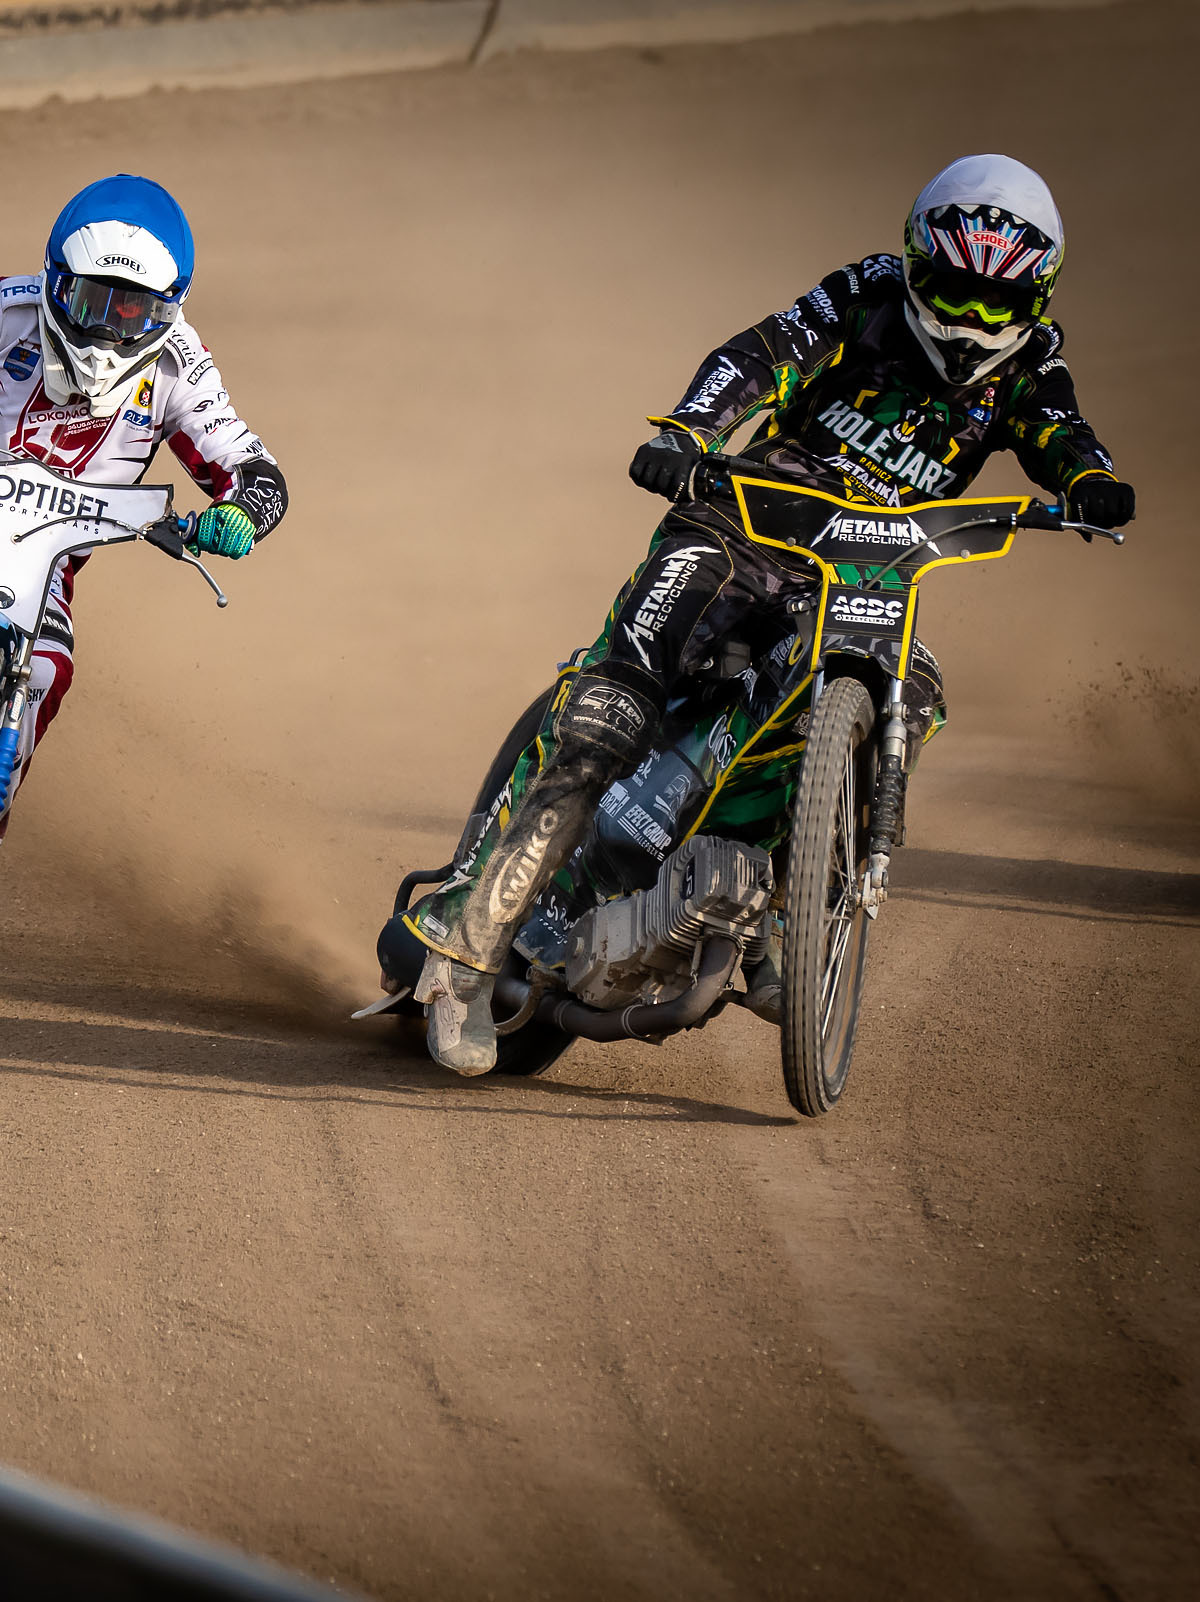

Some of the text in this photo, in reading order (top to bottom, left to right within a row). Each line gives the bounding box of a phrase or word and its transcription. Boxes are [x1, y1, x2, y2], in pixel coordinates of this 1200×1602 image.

[973, 233, 1008, 249] SHOEI
[103, 256, 141, 273] SHOEI
[0, 284, 43, 298] TRO
[28, 407, 90, 424] LOKOMO
[818, 400, 957, 499] KOLEJARZ
[810, 510, 942, 557] METALIKA
[838, 533, 912, 547] RECYCLING
[652, 561, 698, 632] RECYCLING
[622, 546, 722, 671] METALIKA
[830, 595, 904, 619] ACDC
[845, 616, 886, 624] RECYCLING
[625, 804, 672, 851] EFECT GROUP
